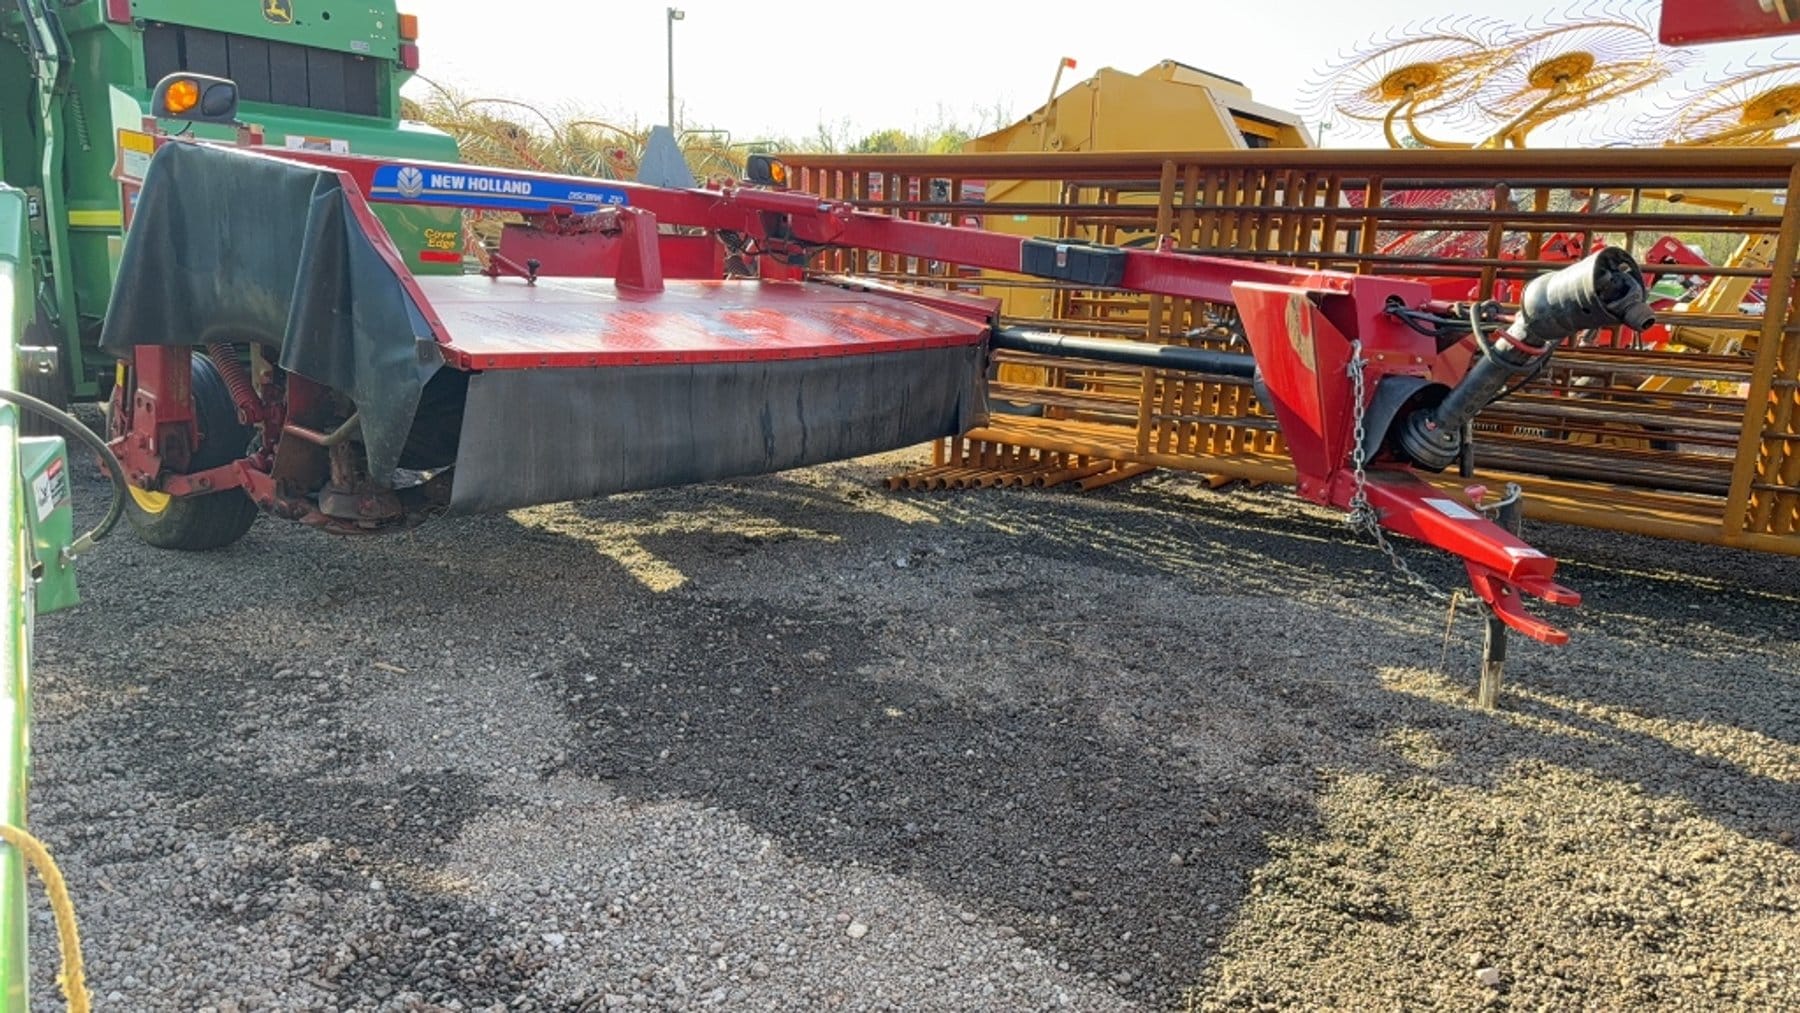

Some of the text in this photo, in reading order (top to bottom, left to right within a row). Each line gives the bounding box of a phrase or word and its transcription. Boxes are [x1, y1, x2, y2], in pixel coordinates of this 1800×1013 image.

[431, 174, 532, 195] NEW HOLLAND
[424, 229, 457, 240] Cover
[428, 239, 456, 249] Edge
